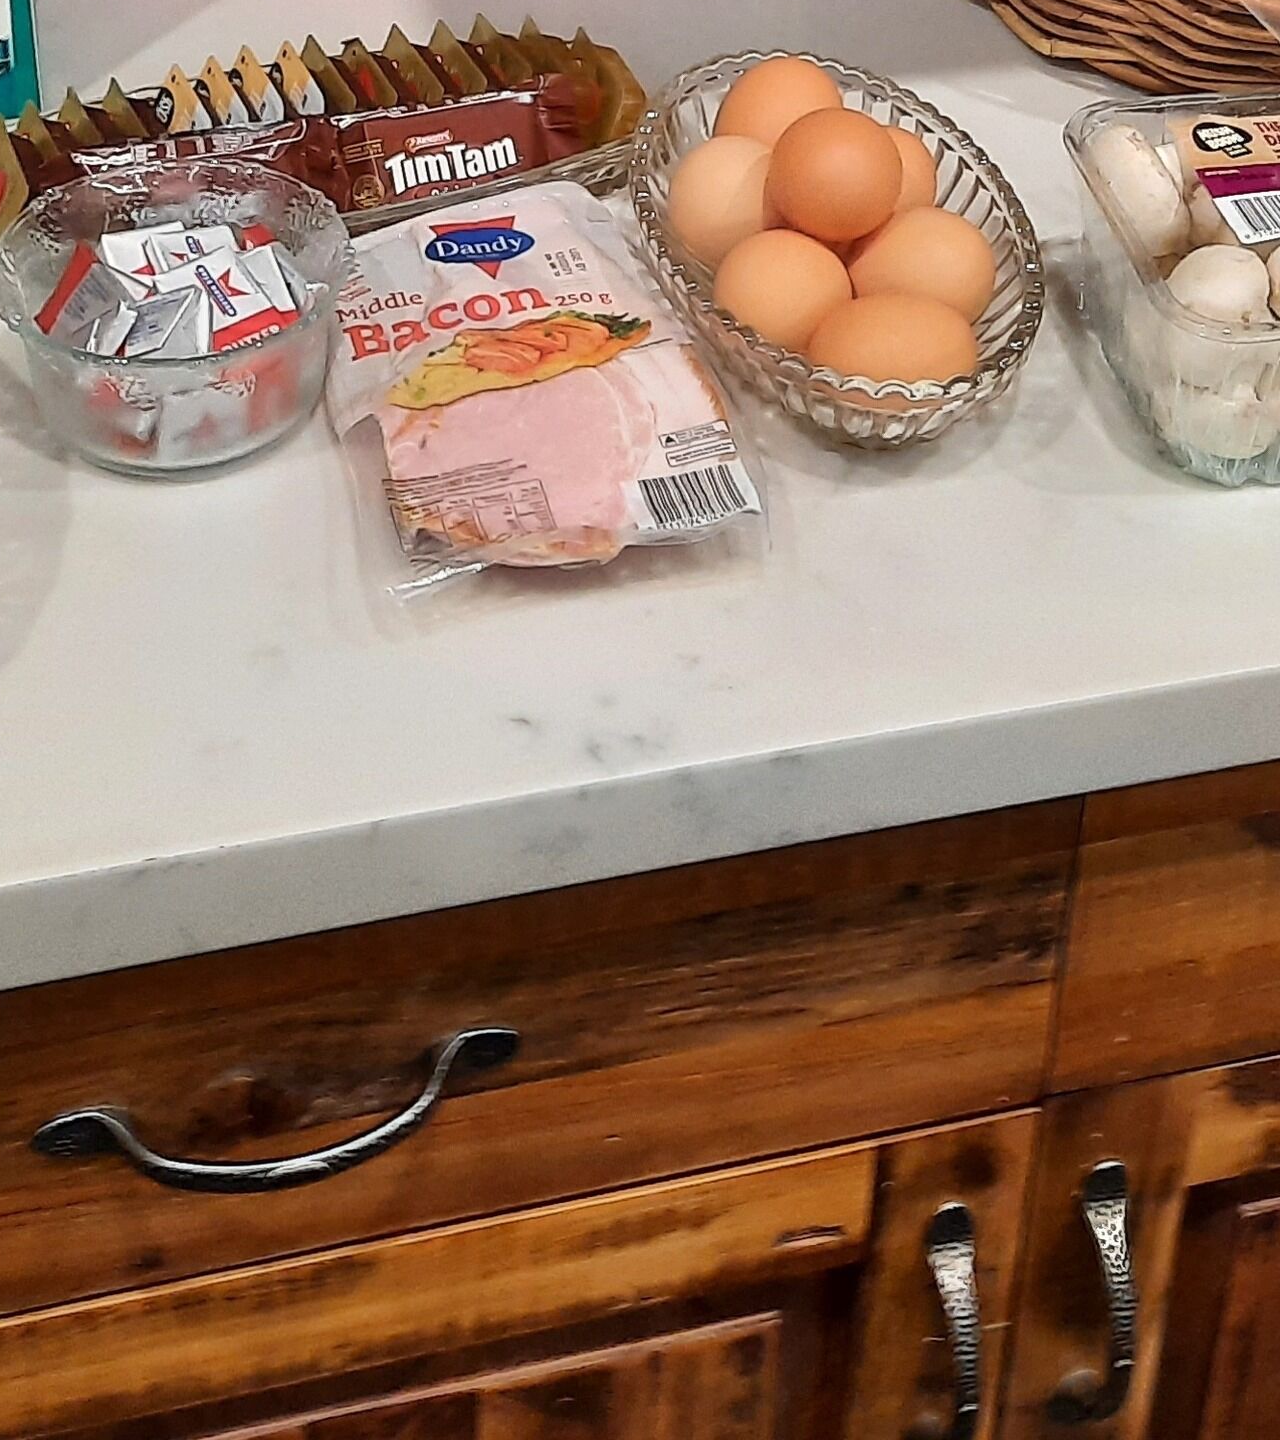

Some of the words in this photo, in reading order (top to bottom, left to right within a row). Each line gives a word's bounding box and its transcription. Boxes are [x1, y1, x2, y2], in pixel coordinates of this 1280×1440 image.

[434, 234, 523, 259] Dandy
[336, 291, 424, 324] Middle
[555, 293, 593, 307] 250
[599, 293, 613, 306] g
[343, 288, 552, 361] Bacon
